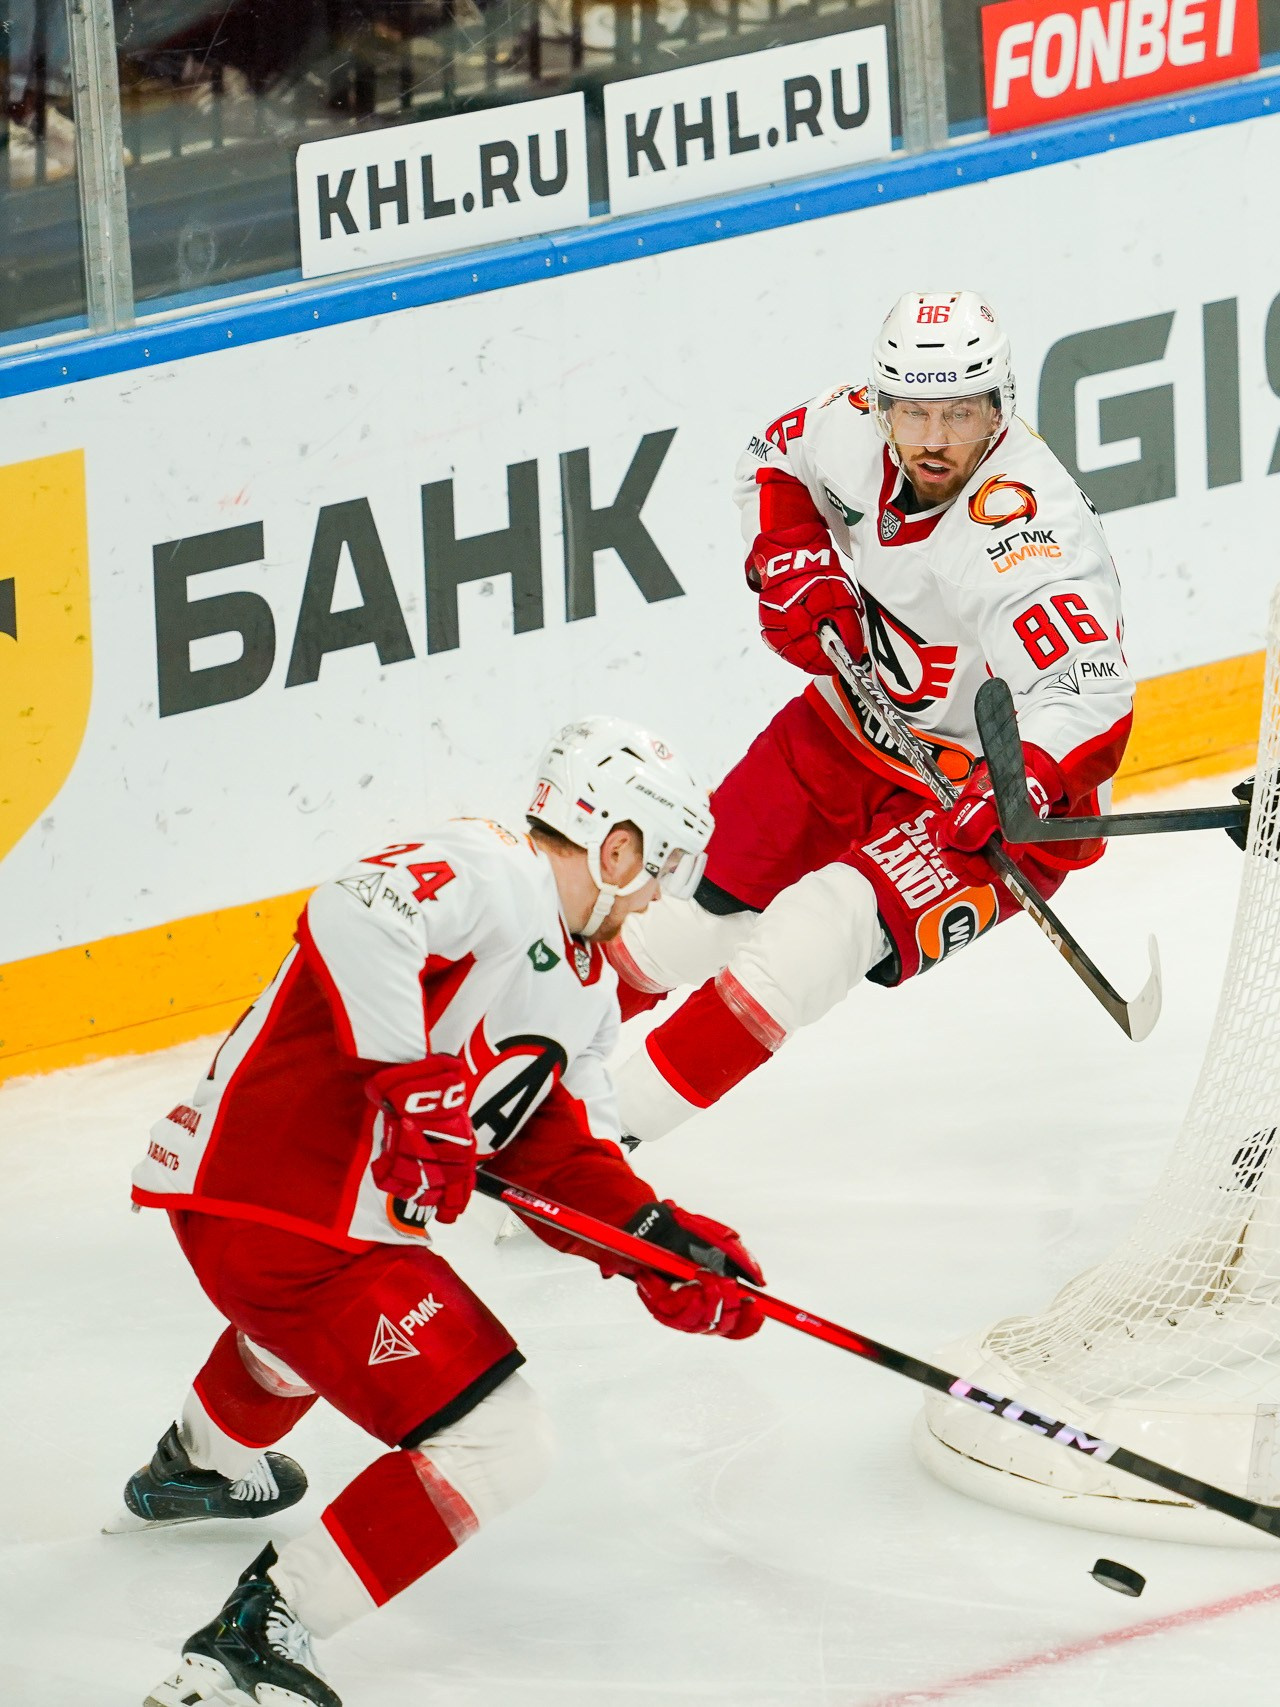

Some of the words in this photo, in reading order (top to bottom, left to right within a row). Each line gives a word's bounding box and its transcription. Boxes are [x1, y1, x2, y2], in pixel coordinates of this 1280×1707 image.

[626, 63, 870, 176] KHL.RU
[318, 129, 567, 240] KHL.RU
[916, 305, 950, 324] 86
[905, 371, 957, 384] согаз
[153, 427, 686, 719] БАНК
[766, 549, 830, 578] CM
[993, 545, 1062, 573] UMMC
[1013, 593, 1108, 670] 86
[528, 783, 551, 814] 24
[635, 785, 675, 809] BAUER
[898, 735, 955, 809] JETSPEED
[954, 802, 972, 826] CCM
[359, 842, 456, 904] 24
[861, 827, 945, 910] LAND
[1005, 873, 1063, 951] CCM
[404, 1080, 466, 1114] CC
[948, 1379, 1121, 1463] CCM
